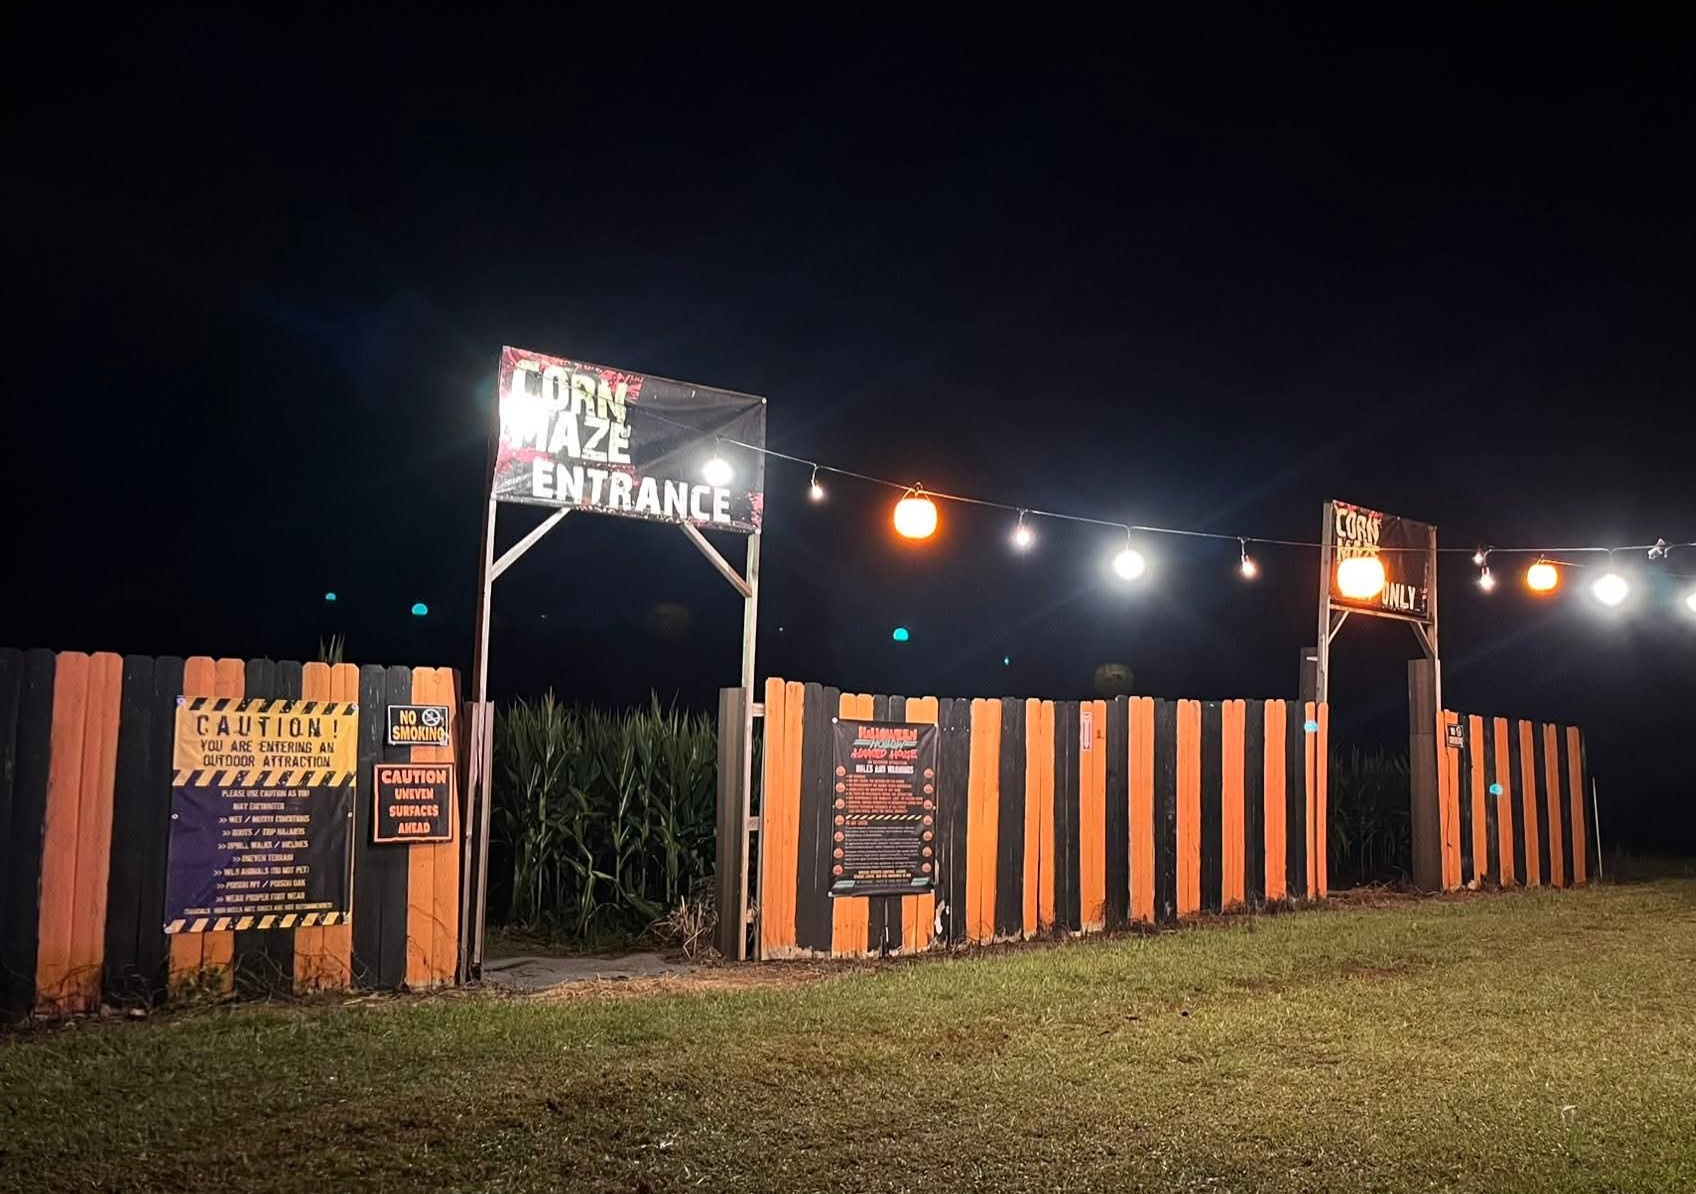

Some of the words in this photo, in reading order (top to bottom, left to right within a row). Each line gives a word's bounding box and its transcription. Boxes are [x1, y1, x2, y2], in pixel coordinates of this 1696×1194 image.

[511, 359, 628, 423] CORN
[510, 404, 632, 464] MAZE
[532, 457, 731, 523] ENTRANCE
[1336, 508, 1380, 545] CORN
[1382, 581, 1416, 610] ONLY
[399, 710, 417, 725] NO
[392, 726, 445, 741] SMOKING
[200, 739, 223, 752] YOU
[231, 740, 252, 752] ARE
[259, 740, 312, 753] ENTERING
[319, 742, 334, 753] AN
[203, 755, 255, 767] OUTDOOR
[263, 755, 330, 768] ATTRACTION
[889, 749, 918, 760] HOUSE
[381, 769, 447, 784] CAUTION
[394, 788, 434, 800] UNEVEN
[389, 805, 439, 817] SURFACES
[398, 822, 431, 834] AHEAD
